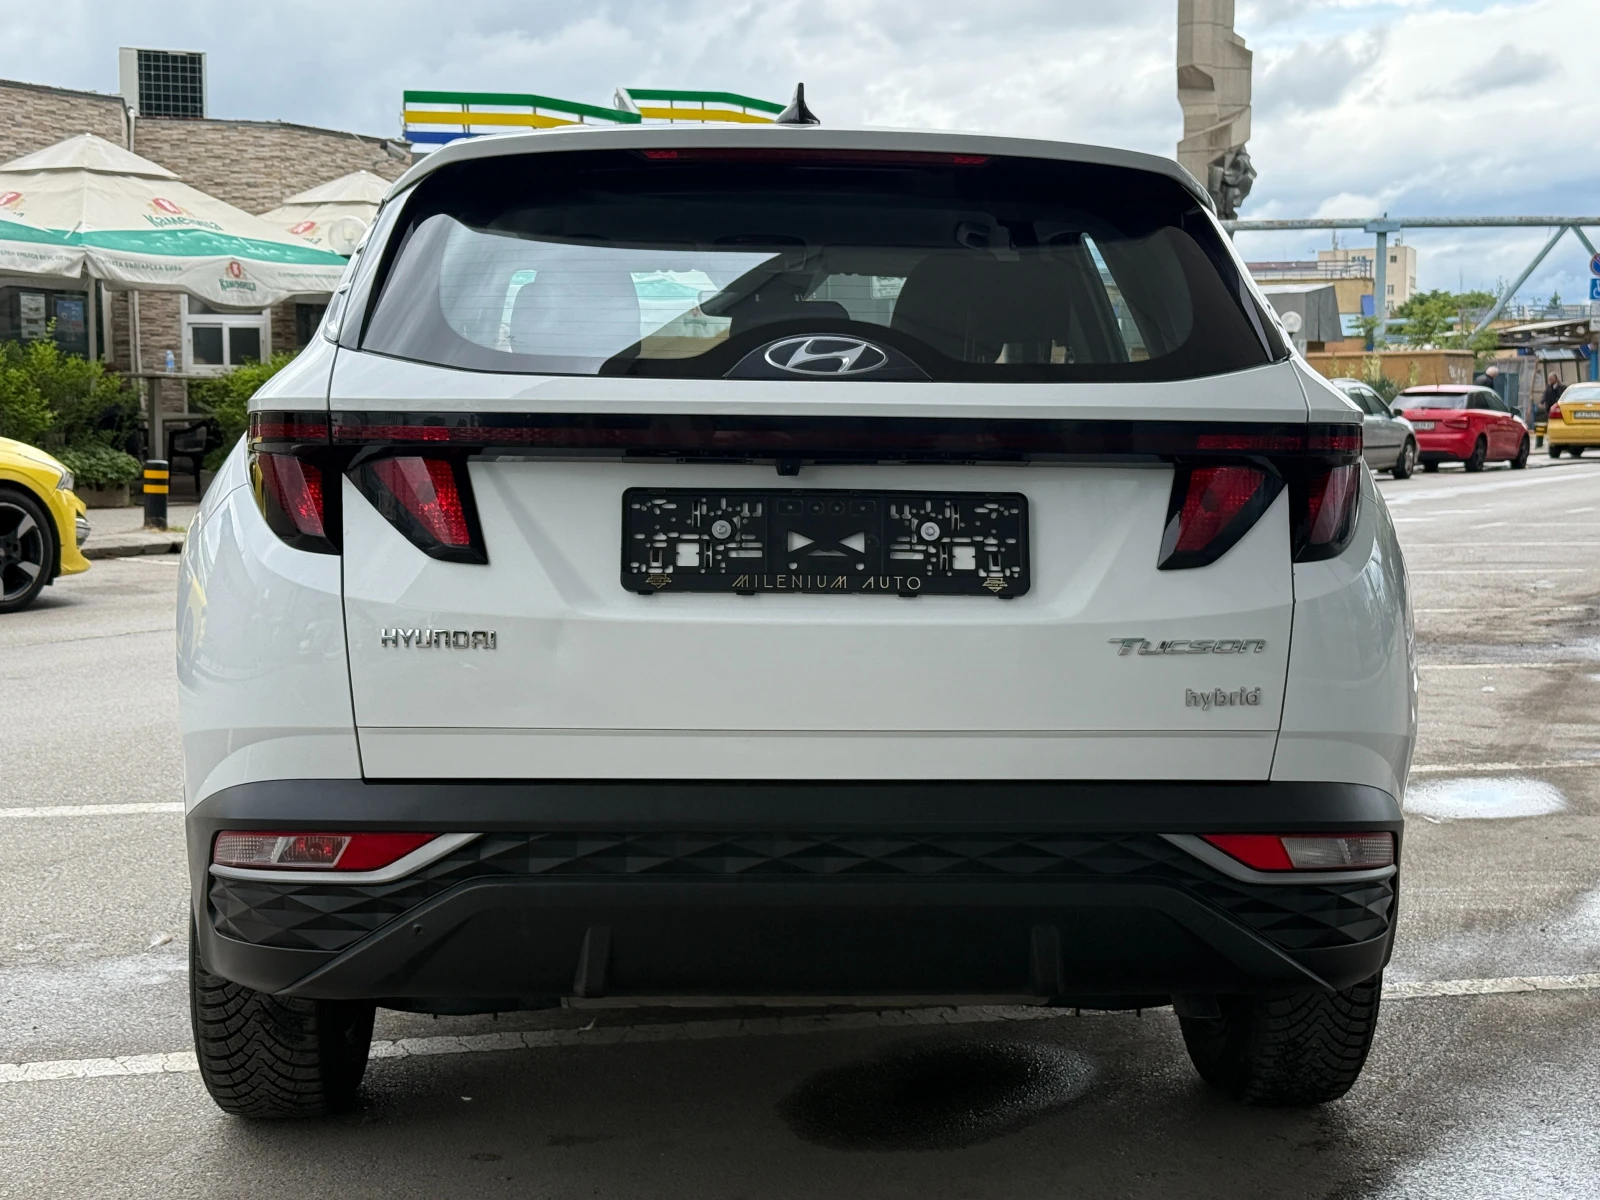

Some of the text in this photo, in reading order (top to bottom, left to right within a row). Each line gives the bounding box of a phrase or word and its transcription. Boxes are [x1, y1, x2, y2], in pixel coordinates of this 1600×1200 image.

[731, 574, 922, 591] MILENIUM AUTO
[381, 628, 497, 650] HYUNDAI
[1185, 685, 1262, 712] hybrid
